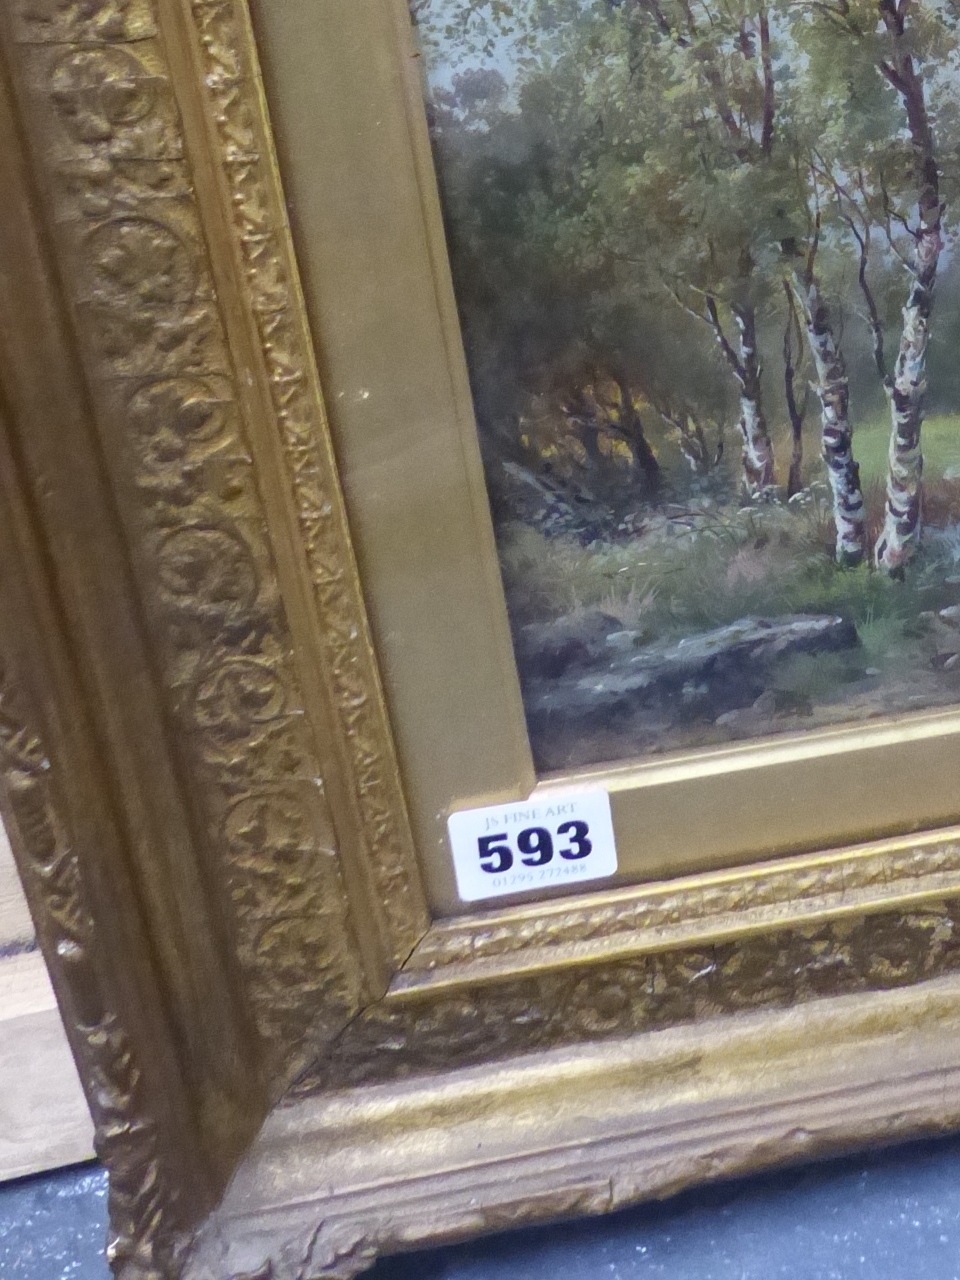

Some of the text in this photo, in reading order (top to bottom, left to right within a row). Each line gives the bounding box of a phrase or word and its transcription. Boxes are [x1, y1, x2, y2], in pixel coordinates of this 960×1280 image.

[504, 808, 541, 825] FINE
[545, 802, 578, 817] ART
[477, 819, 593, 874] 593
[492, 872, 534, 888] 01295
